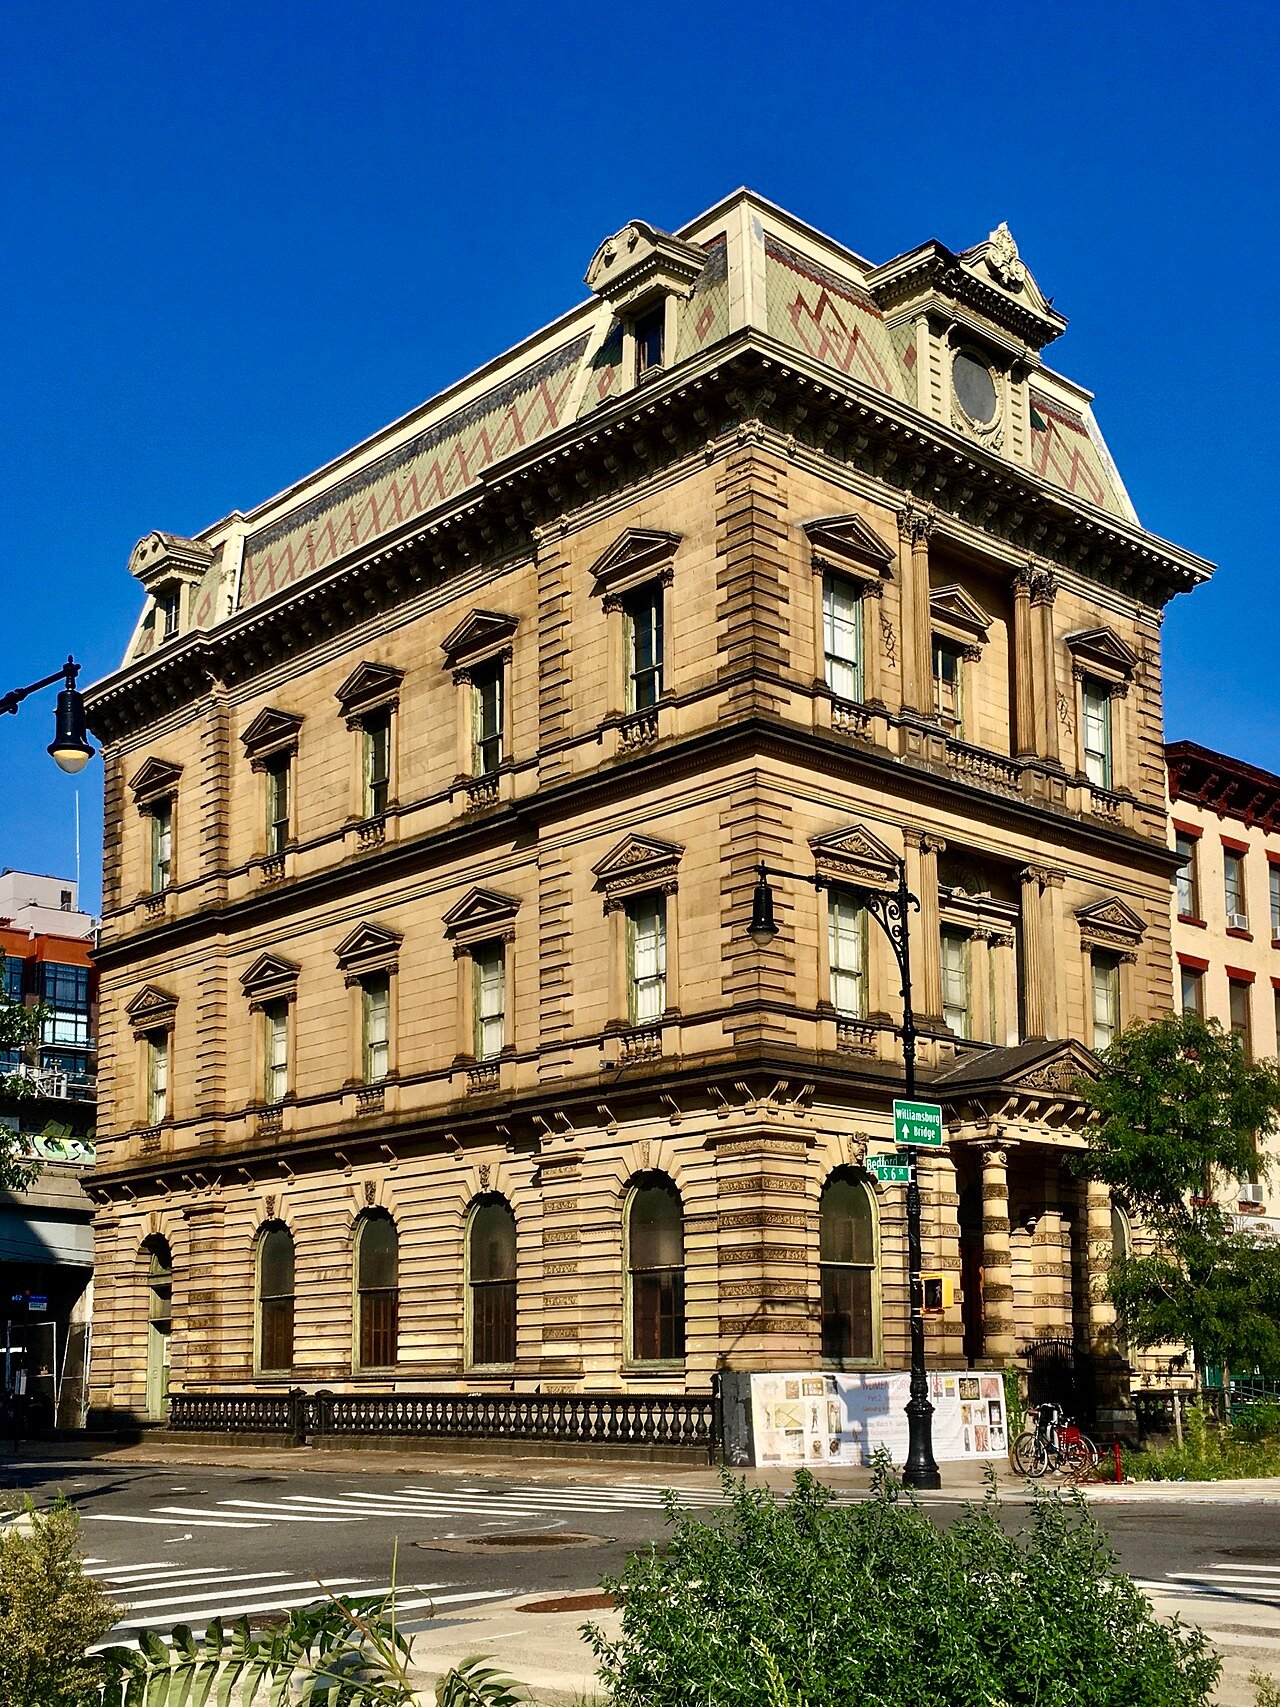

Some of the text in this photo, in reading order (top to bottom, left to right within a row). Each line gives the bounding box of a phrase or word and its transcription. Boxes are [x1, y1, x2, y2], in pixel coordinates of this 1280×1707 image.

[896, 1109, 940, 1126] Williamsburg
[914, 1126, 935, 1140] Bridge
[866, 1155, 898, 1170] Bedford
[884, 1168, 888, 1180] S
[891, 1168, 896, 1180] 6
[862, 1380, 889, 1391] WOMEN
